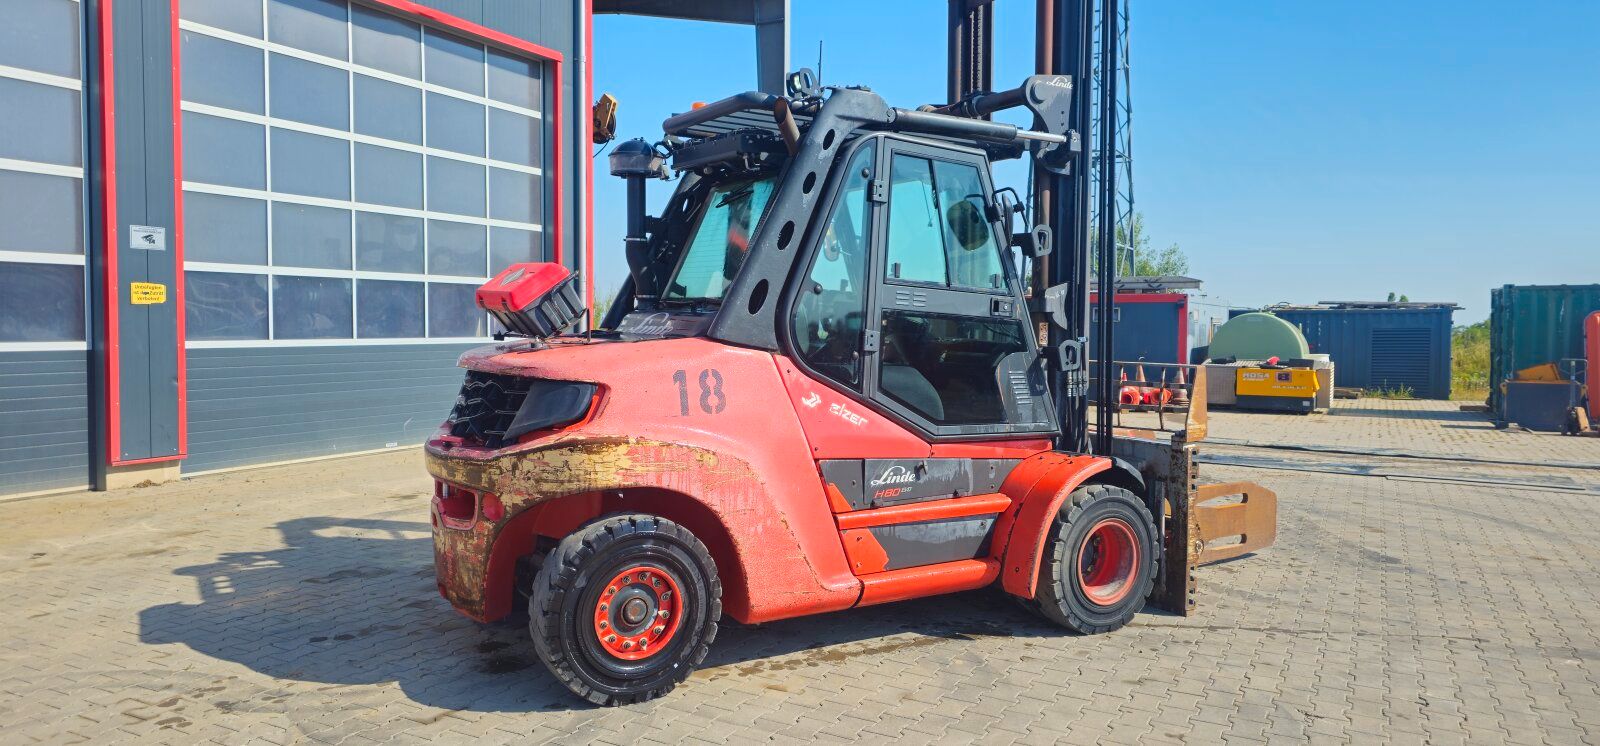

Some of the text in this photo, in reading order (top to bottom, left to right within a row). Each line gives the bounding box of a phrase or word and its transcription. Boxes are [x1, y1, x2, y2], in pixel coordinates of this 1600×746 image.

[1046, 76, 1074, 90] Linde
[629, 312, 674, 336] Linde
[673, 369, 727, 416] 18
[871, 465, 917, 487] Linde
